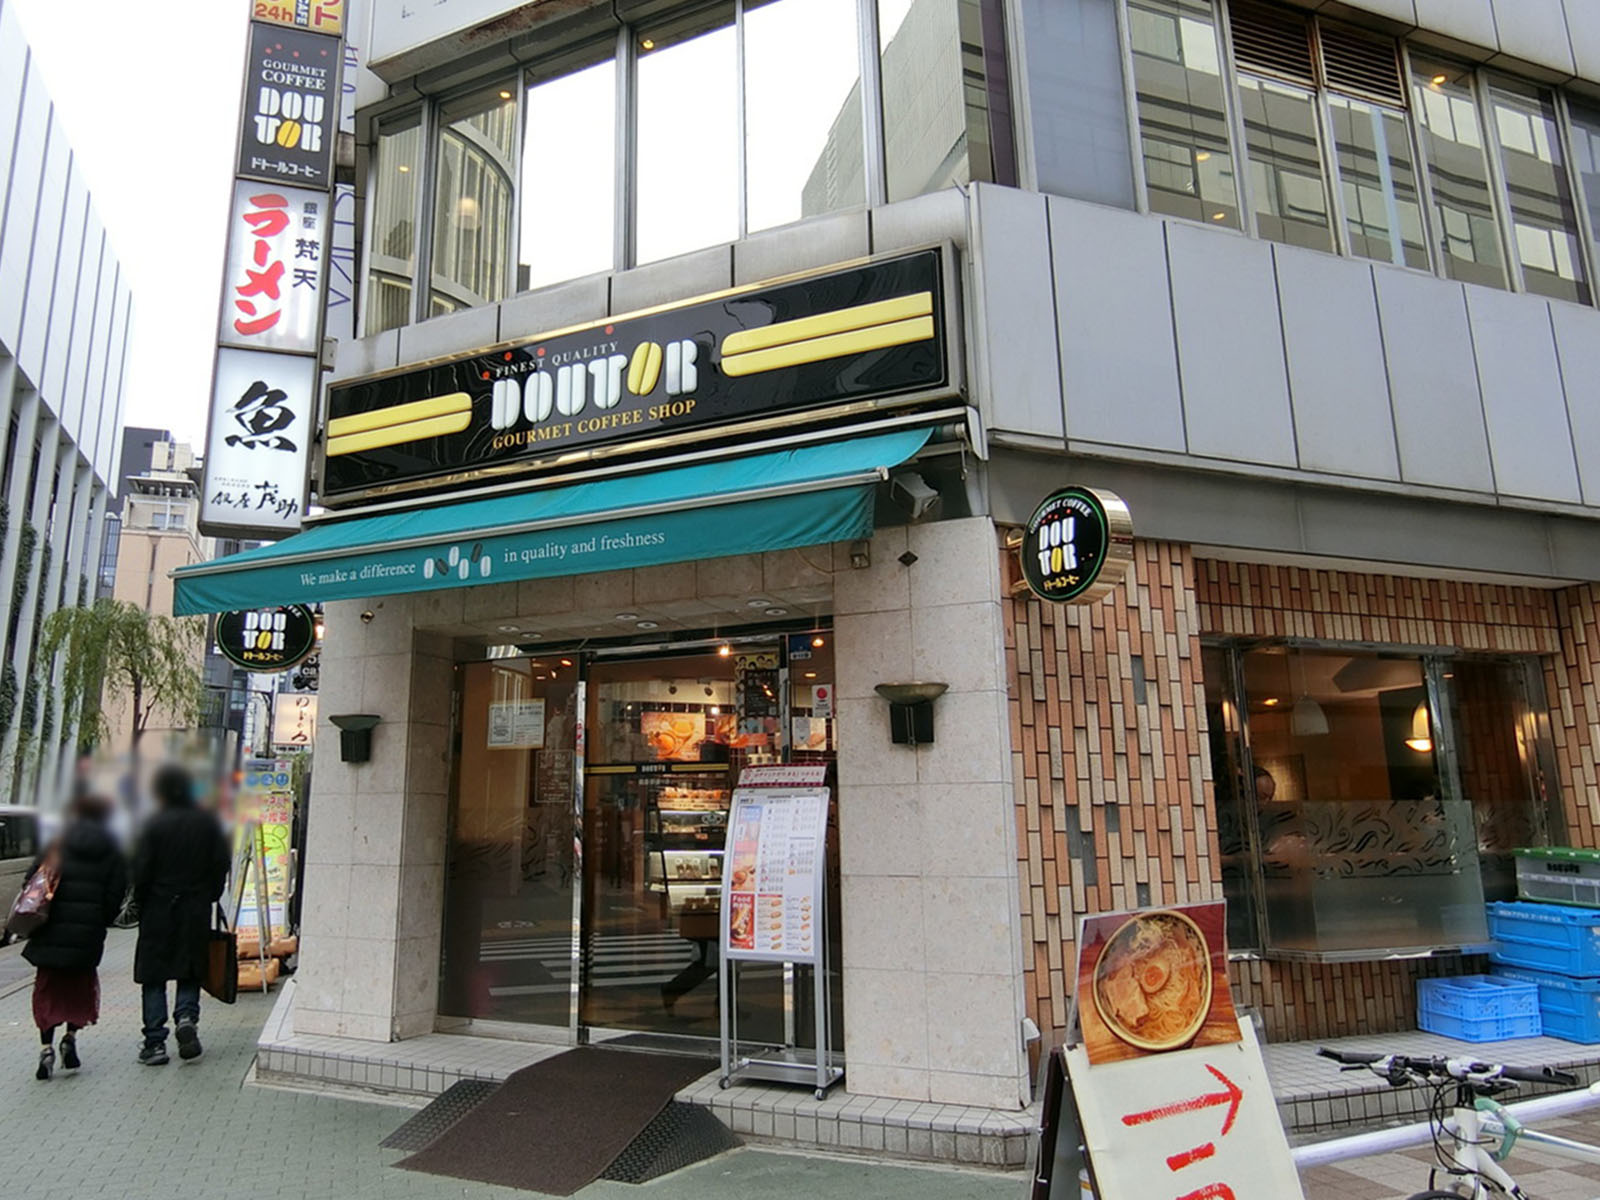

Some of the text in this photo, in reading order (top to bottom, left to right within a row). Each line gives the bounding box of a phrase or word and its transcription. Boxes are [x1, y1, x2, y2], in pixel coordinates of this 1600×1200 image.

[254, 3, 293, 22] 24h
[261, 69, 327, 92] COFFEE
[262, 58, 328, 79] GOURMET
[258, 86, 325, 123] DOU
[253, 115, 323, 153] TOR
[251, 156, 322, 178] ドトールコーヒー
[234, 192, 291, 337] ラーメン
[495, 341, 618, 379] FINEST QUALITY
[491, 338, 699, 431] DOUTOR
[224, 380, 298, 453] 魚
[492, 399, 697, 450] GOURMET COFFEE SHOP
[1038, 516, 1075, 551] DOU
[301, 530, 666, 586] We make a difference in quality and freshness
[1037, 543, 1078, 577] TOR
[245, 611, 287, 632] DOU
[242, 630, 286, 650] TOR
